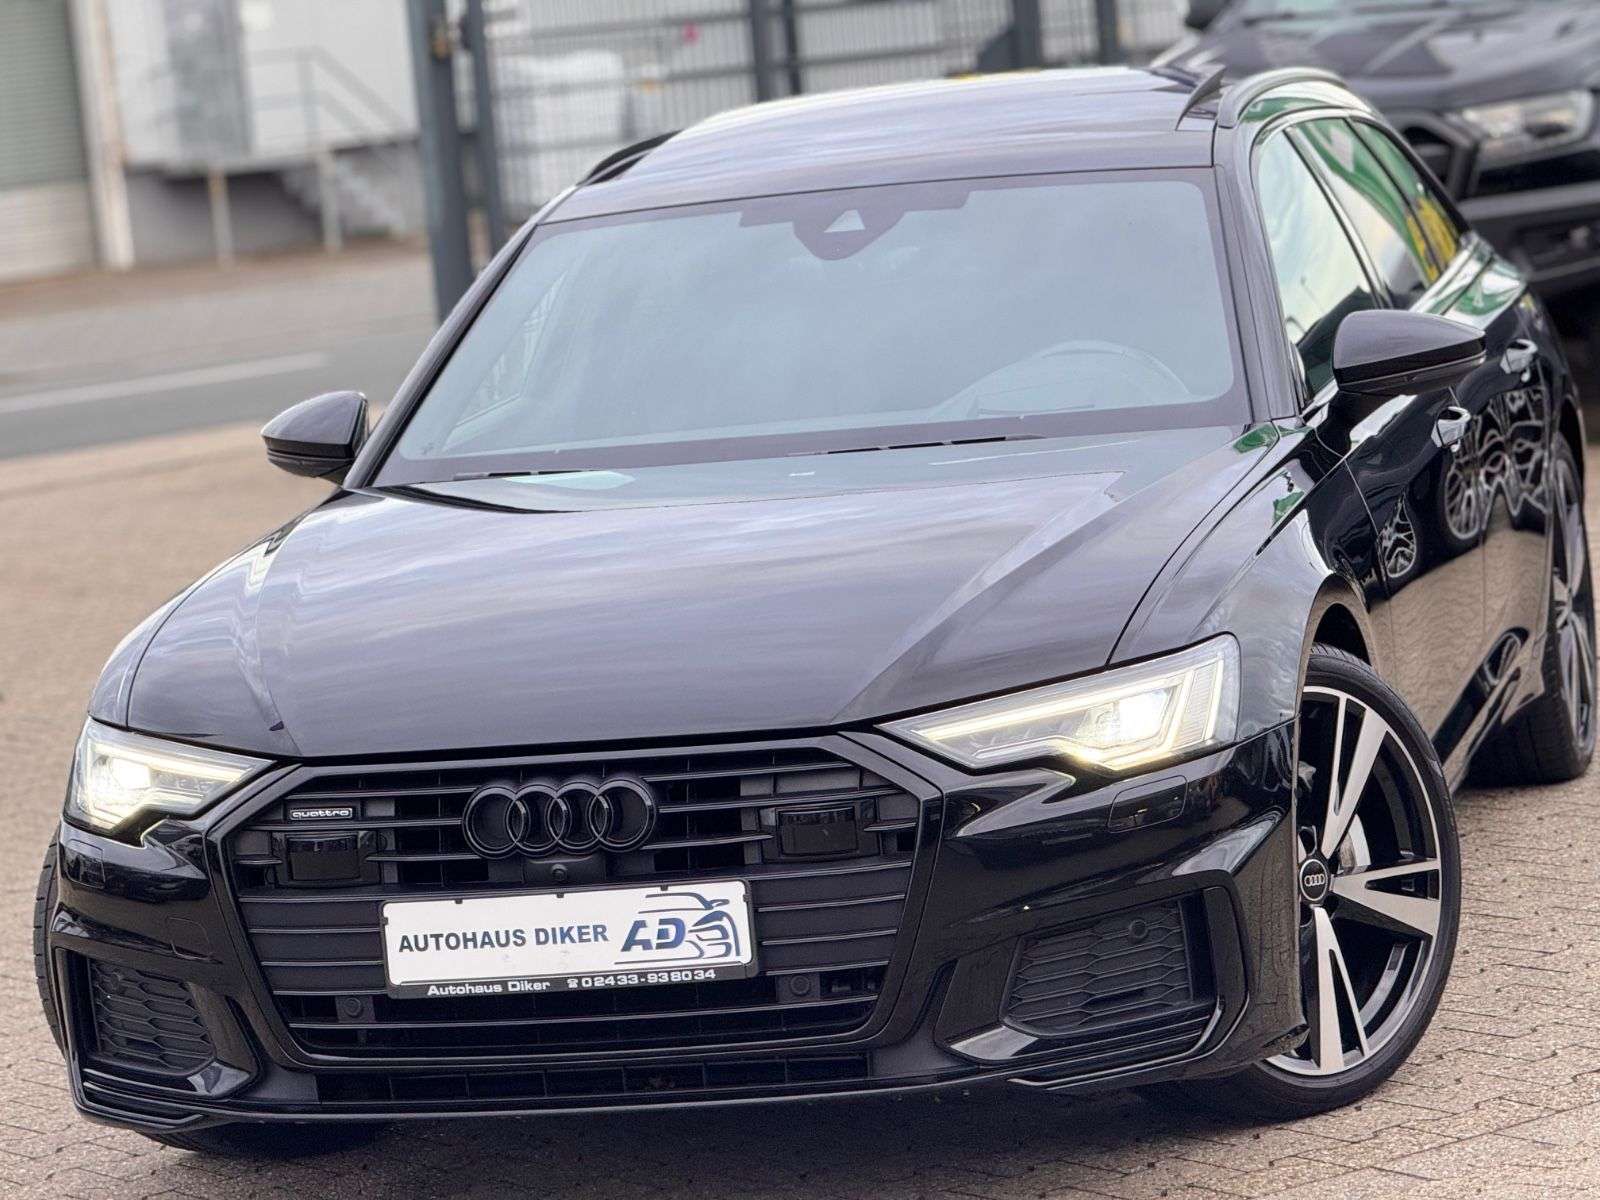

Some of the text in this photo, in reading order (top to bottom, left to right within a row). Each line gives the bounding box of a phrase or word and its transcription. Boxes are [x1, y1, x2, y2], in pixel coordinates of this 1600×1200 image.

[292, 810, 350, 820] quattro
[398, 924, 609, 953] AUTOHAUS DIKER
[620, 917, 687, 952] AD
[427, 982, 502, 997] Autohaus
[507, 979, 551, 993] Diker
